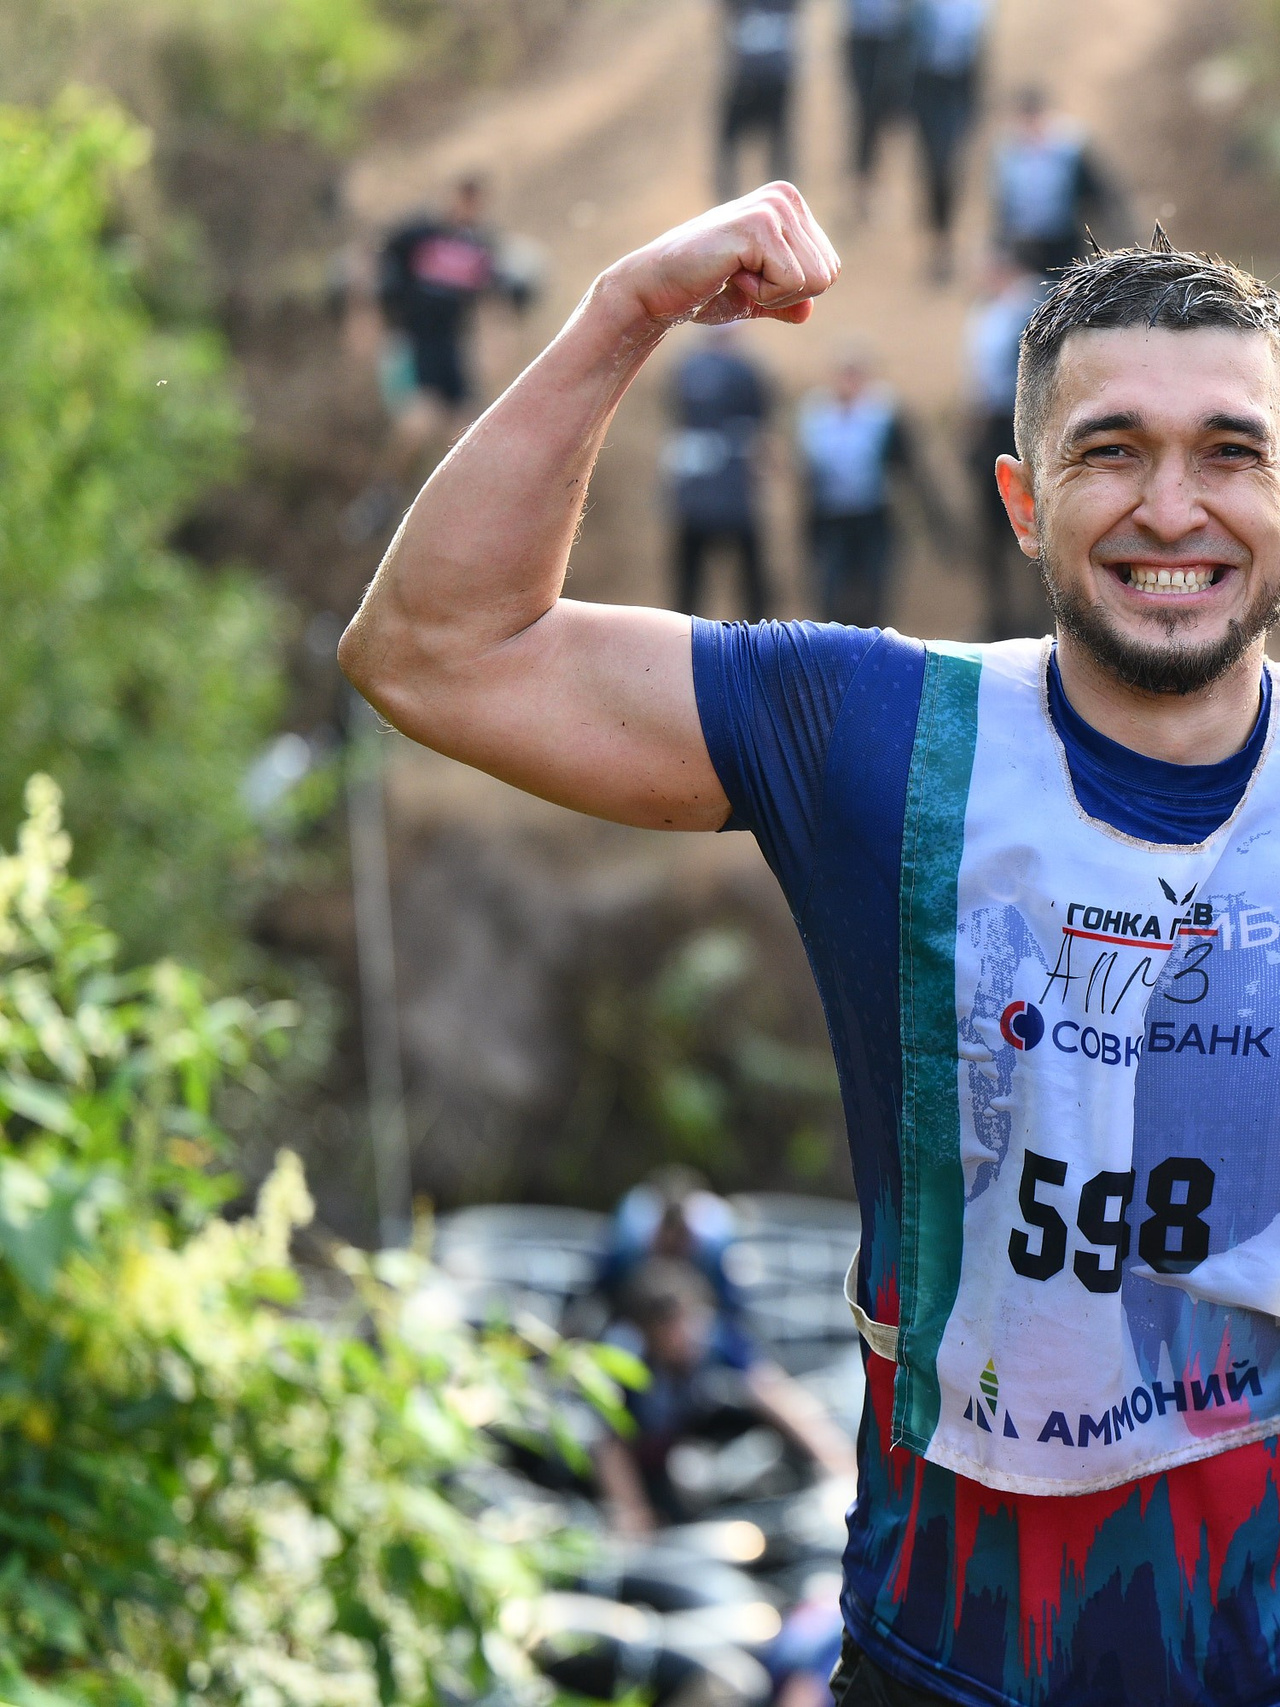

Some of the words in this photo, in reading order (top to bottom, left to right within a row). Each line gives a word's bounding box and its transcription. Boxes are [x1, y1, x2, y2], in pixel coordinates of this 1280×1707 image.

[1067, 902, 1161, 940] ГОНКА
[1052, 1020, 1275, 1067] СОВКБАНК
[1007, 1148, 1216, 1294] 598
[1037, 1358, 1264, 1449] АММОНИЙ
